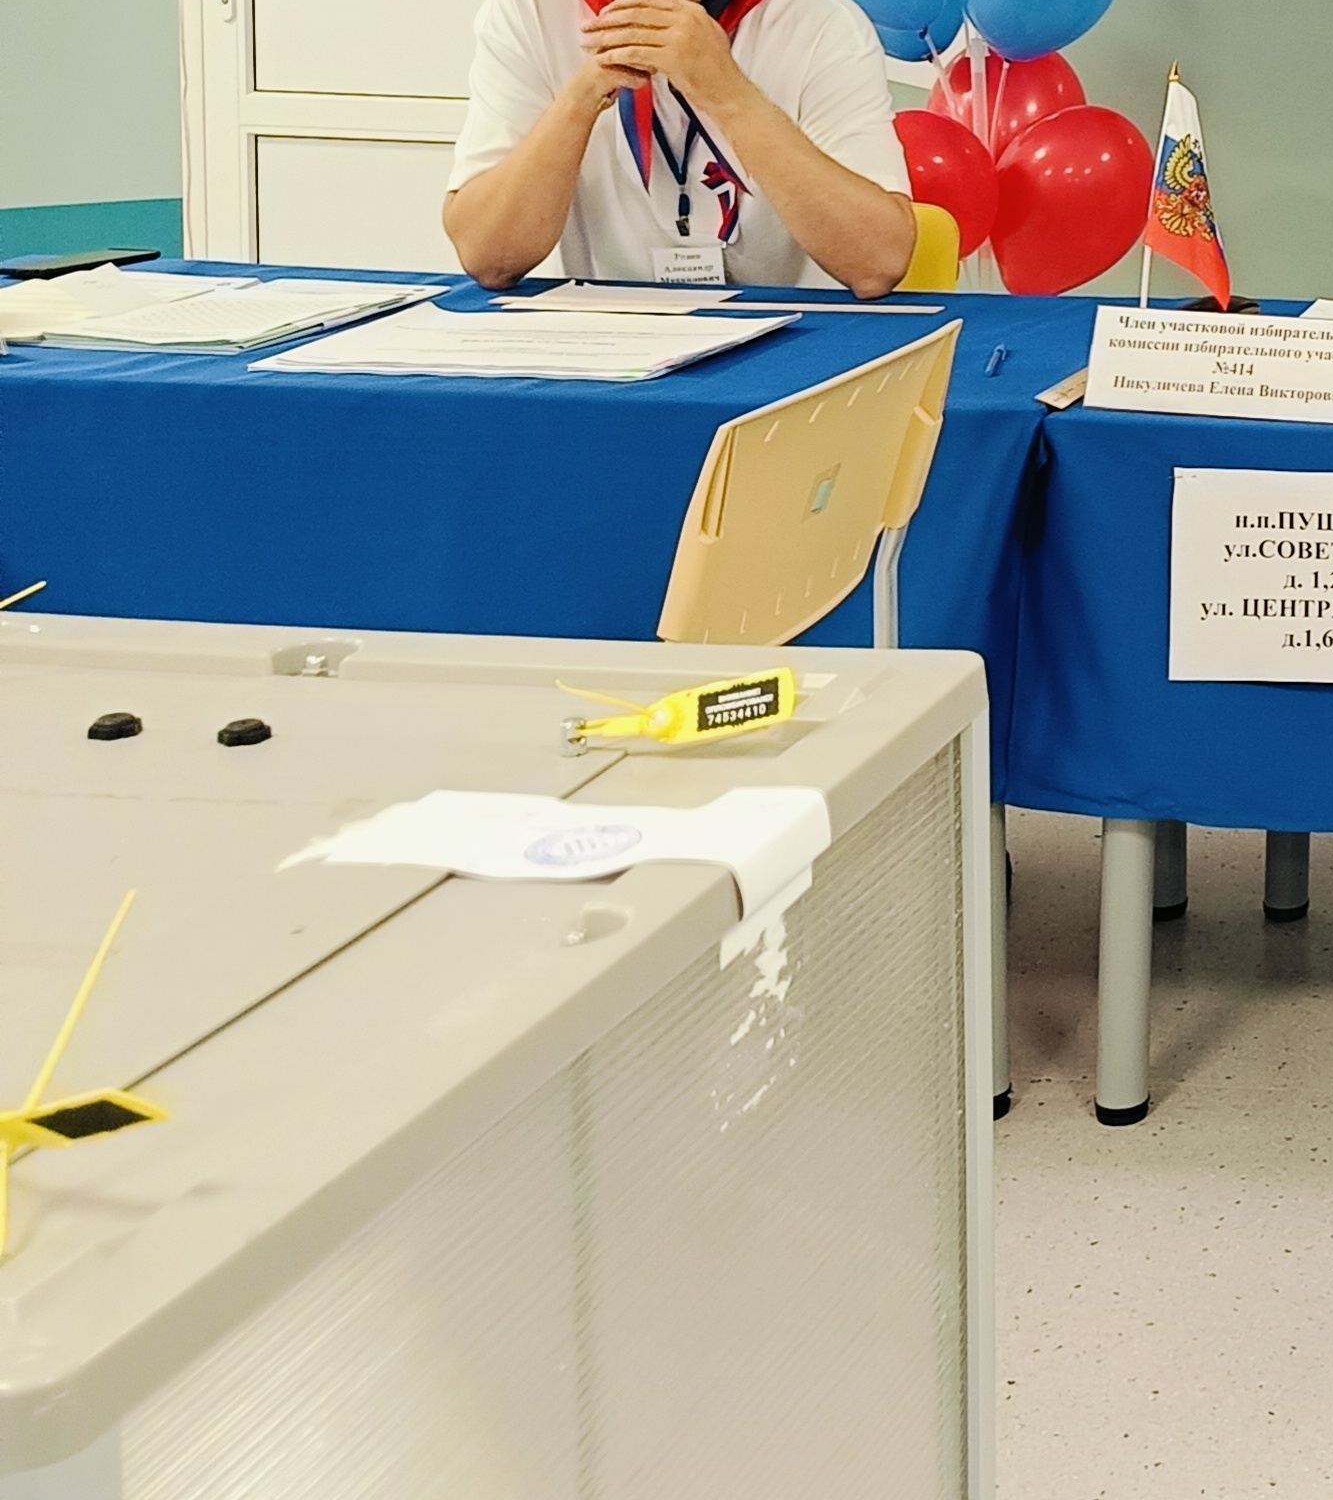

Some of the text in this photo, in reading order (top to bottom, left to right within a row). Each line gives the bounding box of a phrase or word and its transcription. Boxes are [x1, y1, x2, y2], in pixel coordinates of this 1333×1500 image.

[1118, 315, 1156, 330] Член
[1159, 321, 1246, 337] участковой
[1108, 338, 1181, 353] комиссии
[1183, 340, 1302, 359] избирательного
[1212, 361, 1255, 376] №414
[1112, 375, 1205, 394] Никуличева
[1209, 381, 1255, 398] Елена
[1283, 573, 1303, 591] д.
[1200, 601, 1234, 621] ул.
